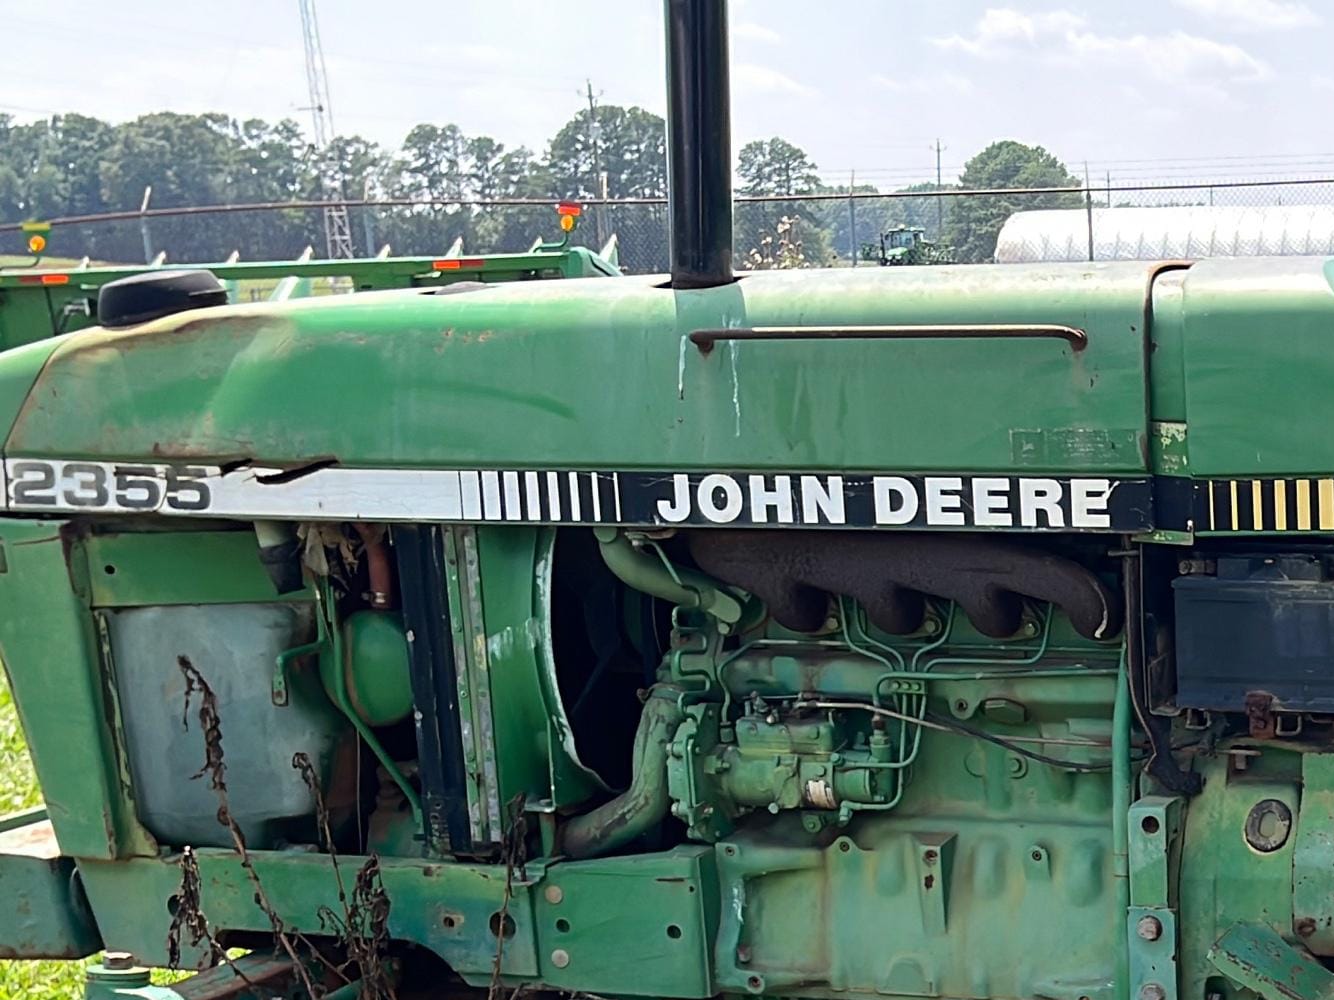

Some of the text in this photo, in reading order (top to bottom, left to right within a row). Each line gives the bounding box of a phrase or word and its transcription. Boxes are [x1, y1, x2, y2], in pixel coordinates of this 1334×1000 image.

[13, 462, 211, 510] 2355
[656, 474, 1111, 528] JOHN DEERE
